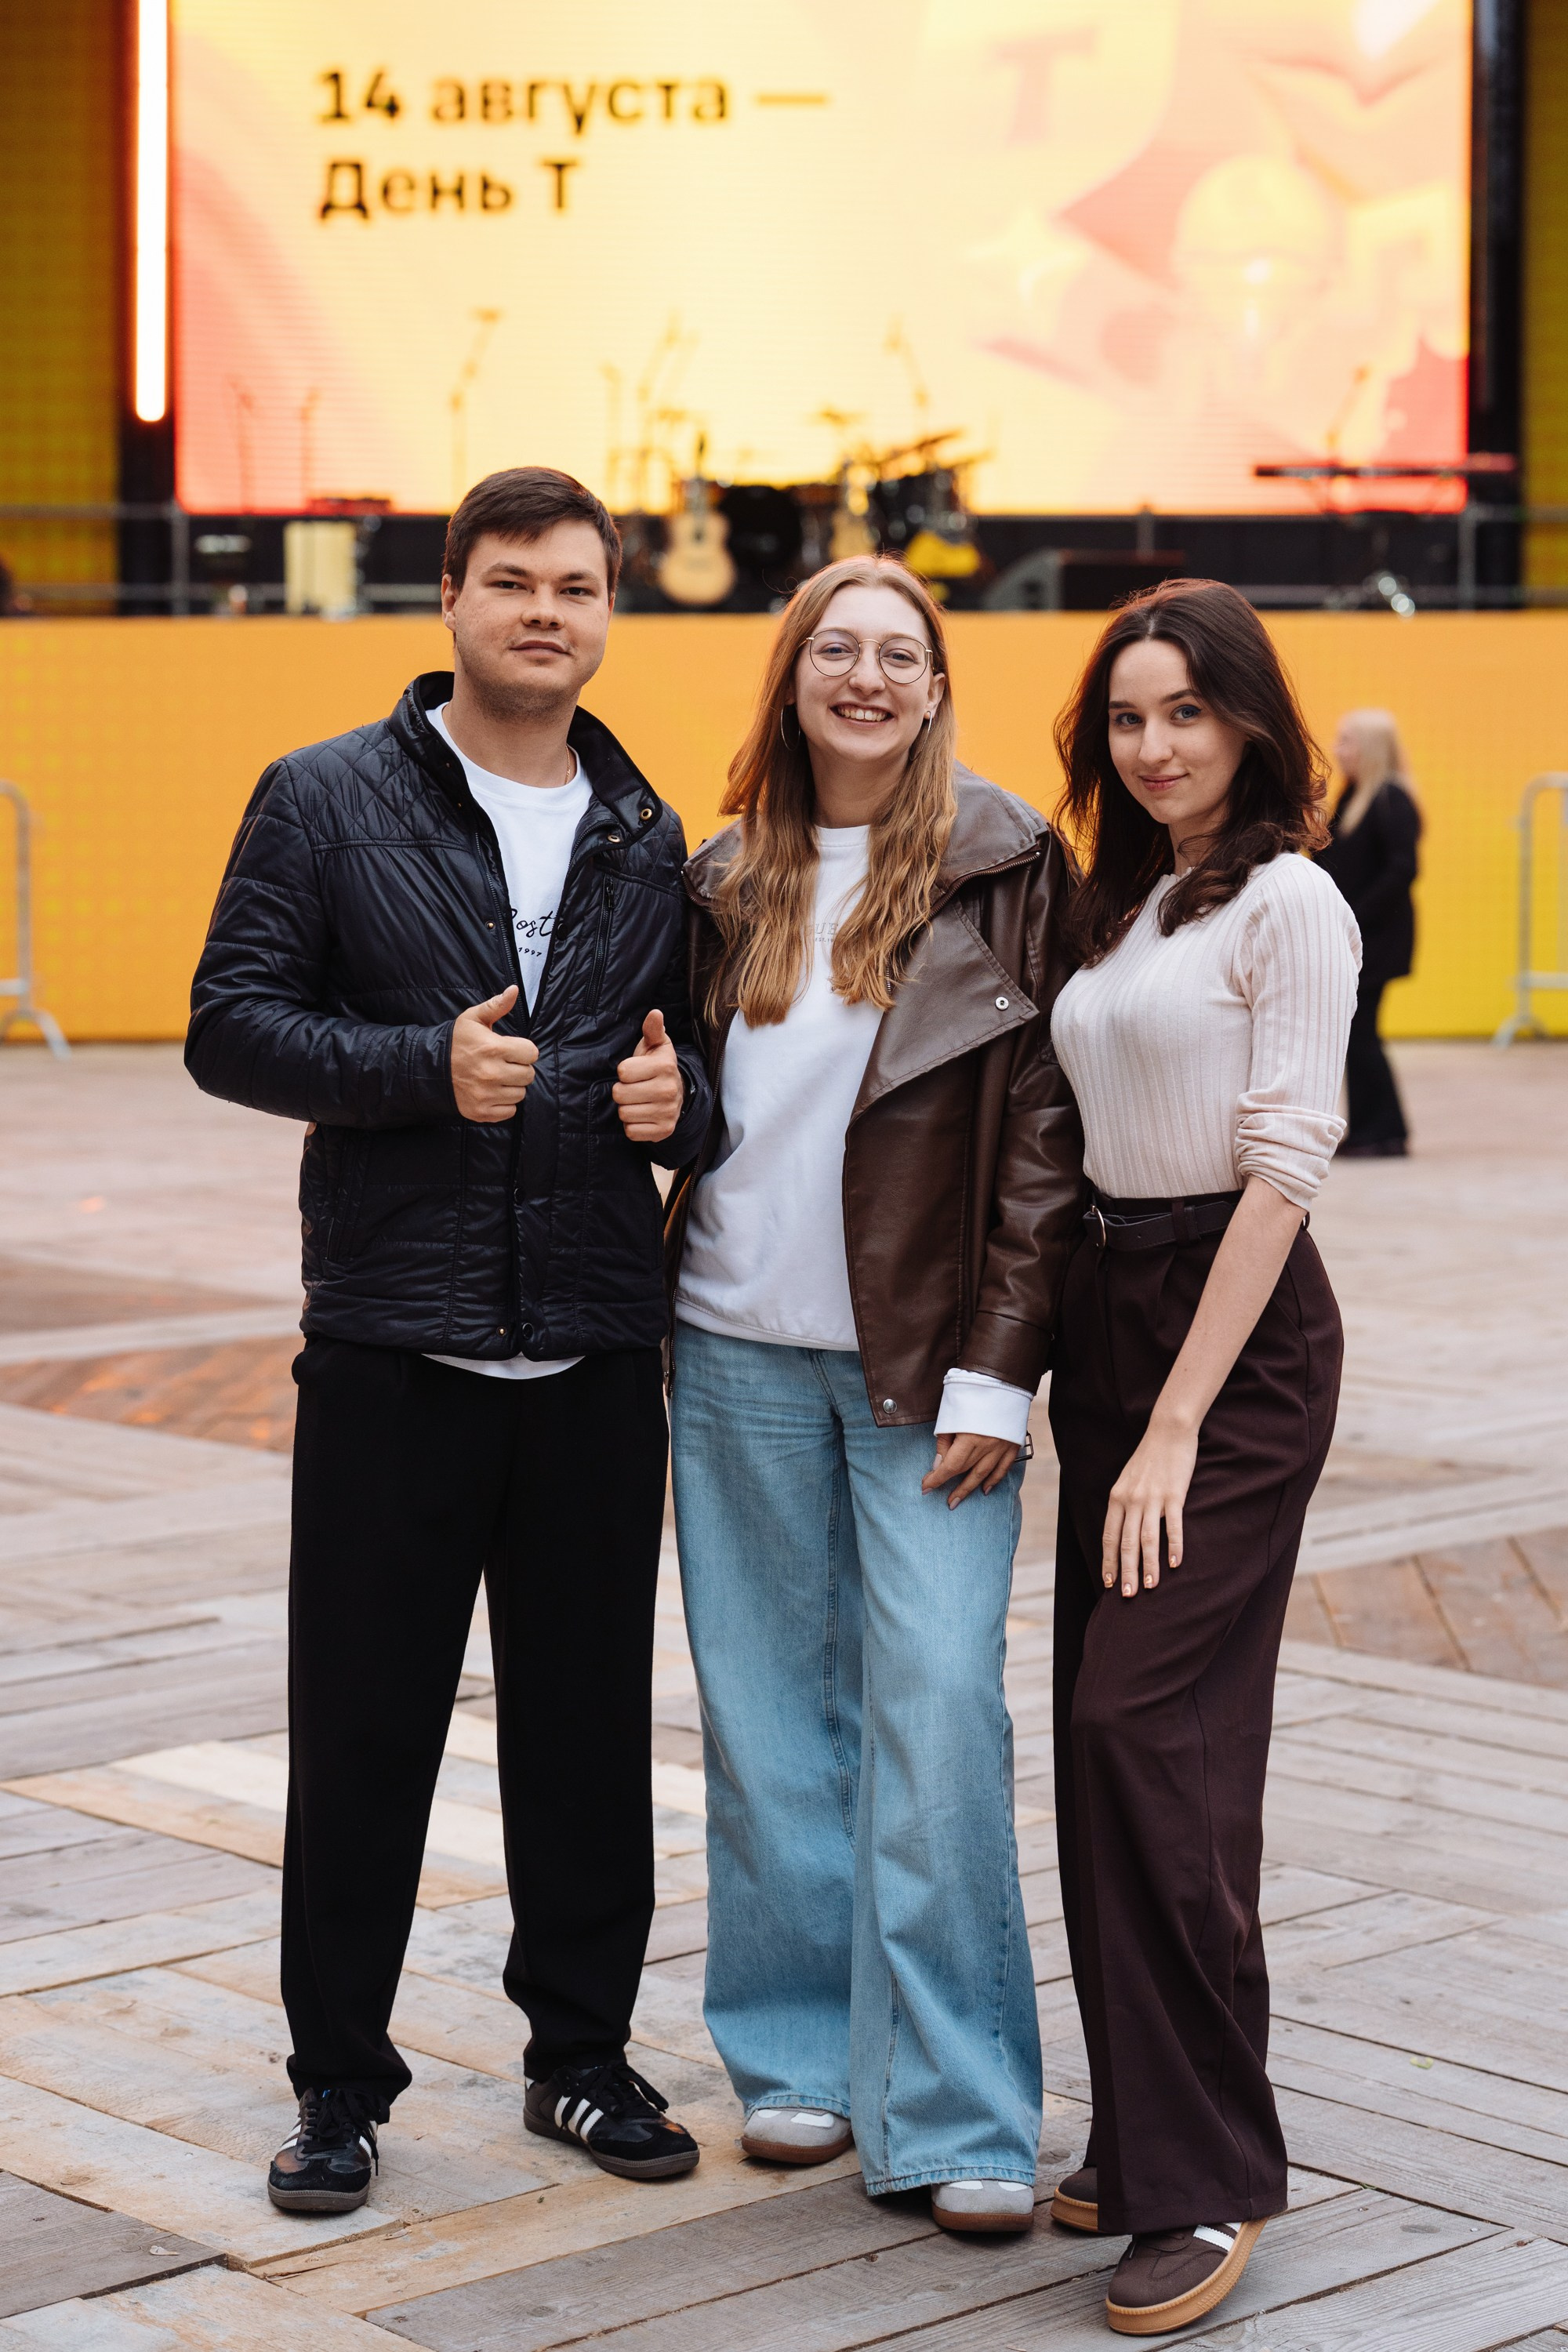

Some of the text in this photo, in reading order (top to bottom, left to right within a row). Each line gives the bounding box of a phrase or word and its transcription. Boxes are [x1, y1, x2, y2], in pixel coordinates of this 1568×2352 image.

[318, 69, 403, 124] 14
[430, 80, 728, 136] августа
[315, 158, 578, 223] День Т
